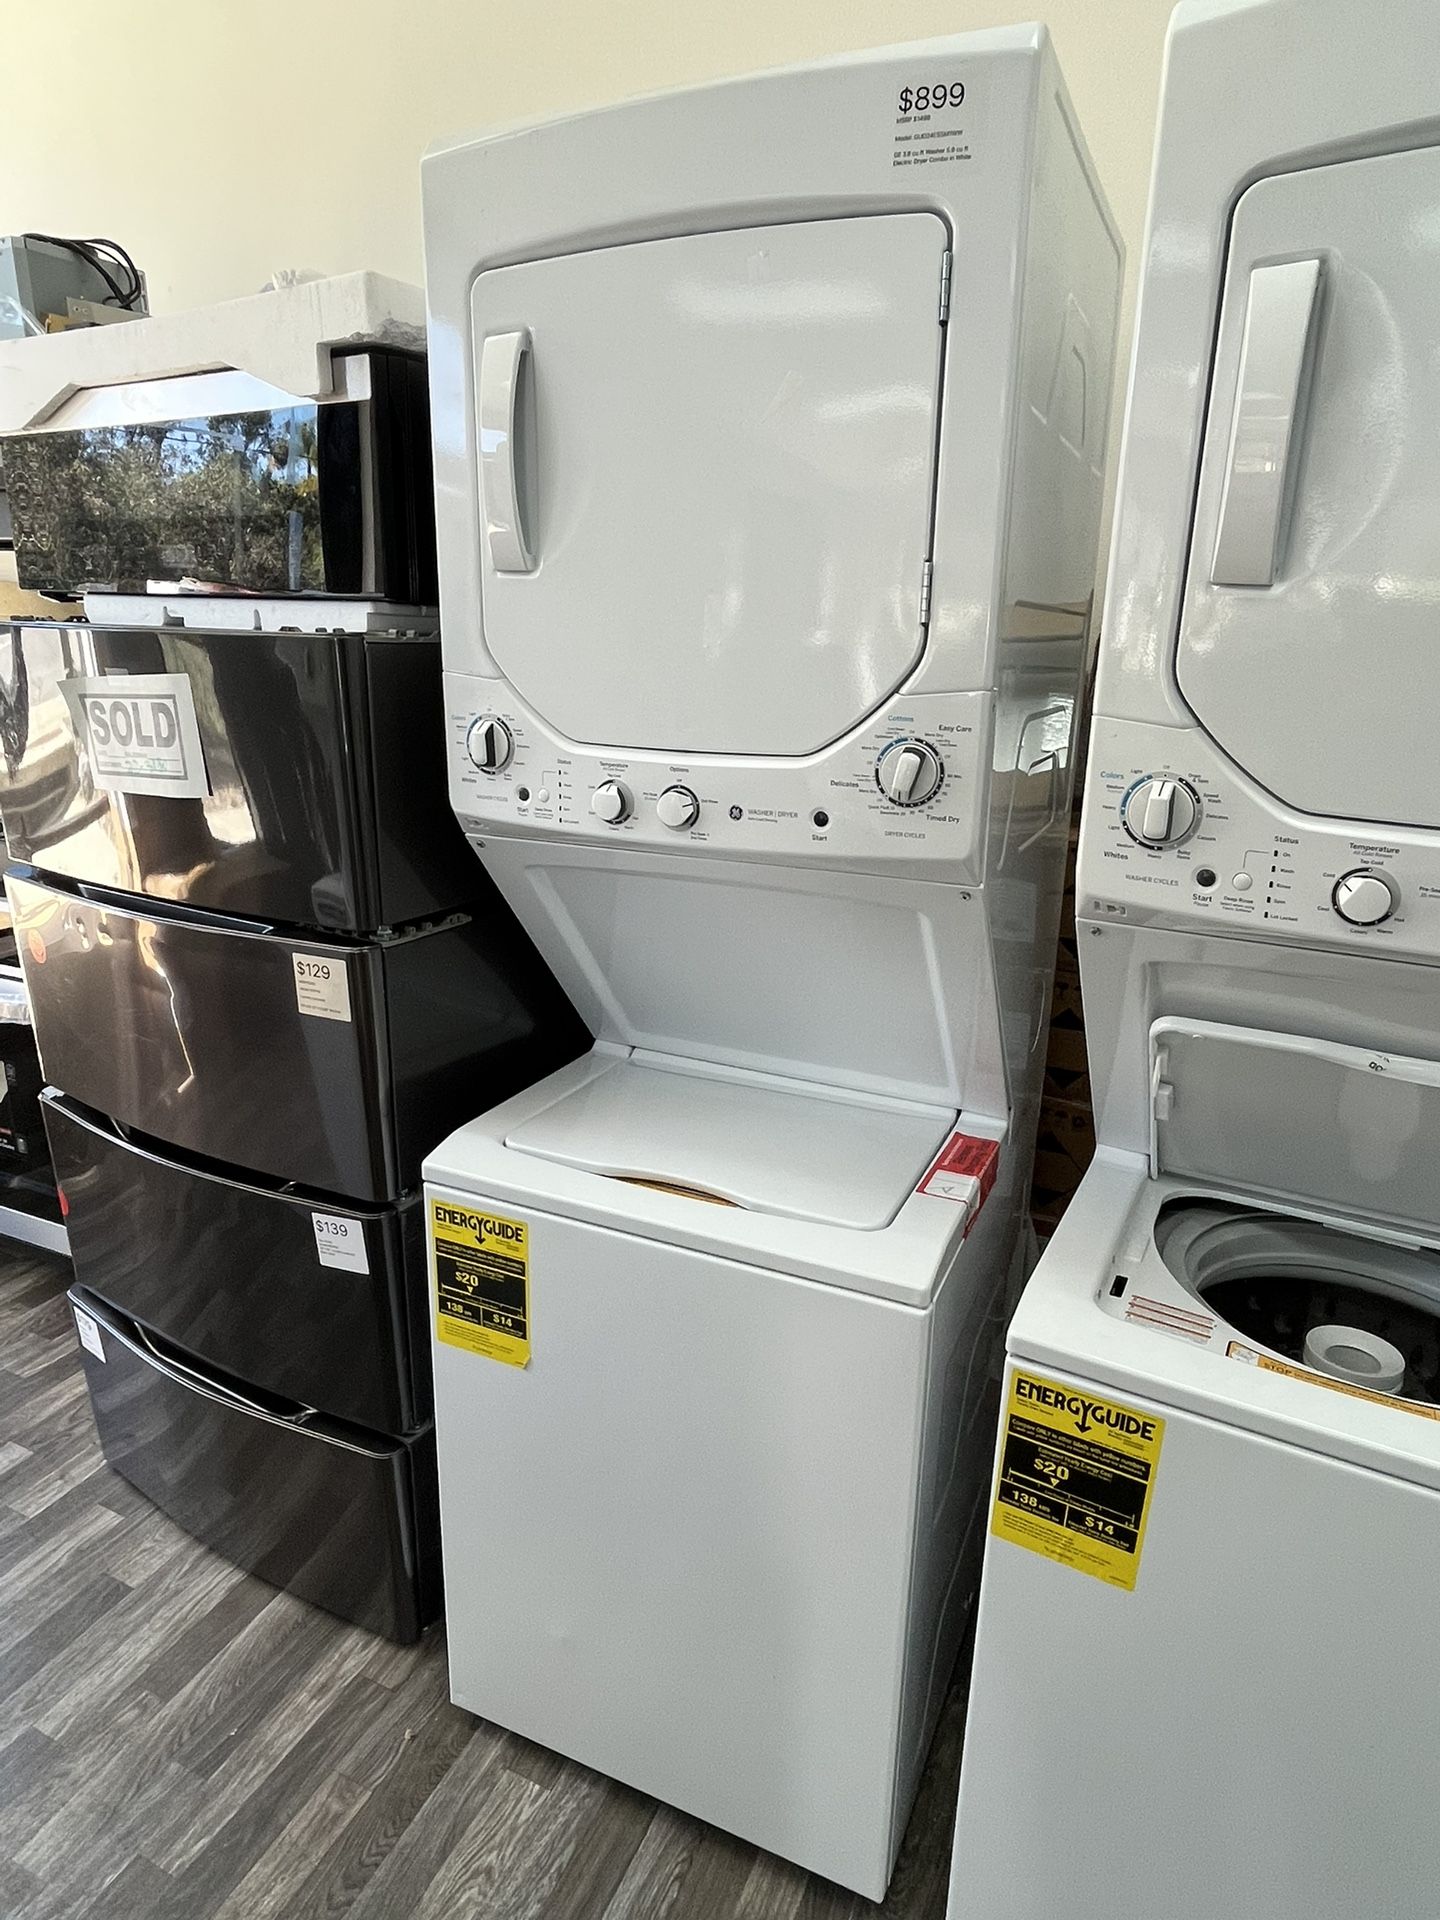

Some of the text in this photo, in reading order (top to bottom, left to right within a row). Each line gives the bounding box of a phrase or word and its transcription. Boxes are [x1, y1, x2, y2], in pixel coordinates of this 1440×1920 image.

[899, 82, 965, 114] $899
[89, 700, 177, 748] SOLD
[939, 724, 972, 733] Easy Care
[1100, 771, 1124, 780] Colors
[830, 780, 859, 788] Delicates
[948, 815, 960, 824] Dry
[1274, 835, 1299, 845] Status
[1103, 850, 1128, 860] Whites
[1349, 842, 1400, 854] Temperature
[1125, 874, 1179, 887] WASHER CYCLES
[1192, 893, 1212, 902] Start
[297, 961, 330, 979] $129
[316, 1220, 348, 1237] $139
[435, 1206, 523, 1243] ENERGYGUIDE
[455, 1271, 479, 1287] $20
[446, 1302, 463, 1314] 138
[493, 1314, 512, 1327] $14
[1264, 1363, 1292, 1376] STOP
[1015, 1377, 1156, 1442] ENERGYGUIDE
[1012, 1418, 1035, 1431] Compare
[1036, 1427, 1051, 1437] ONLY
[1058, 1436, 1072, 1444] other
[1073, 1441, 1089, 1451] labels
[1102, 1452, 1120, 1462] yellow
[1034, 1458, 1069, 1480] $20
[1037, 1447, 1113, 1478] Estimated Yearly Energy Cost
[1012, 1490, 1037, 1507] 138
[1085, 1516, 1114, 1535] $14
